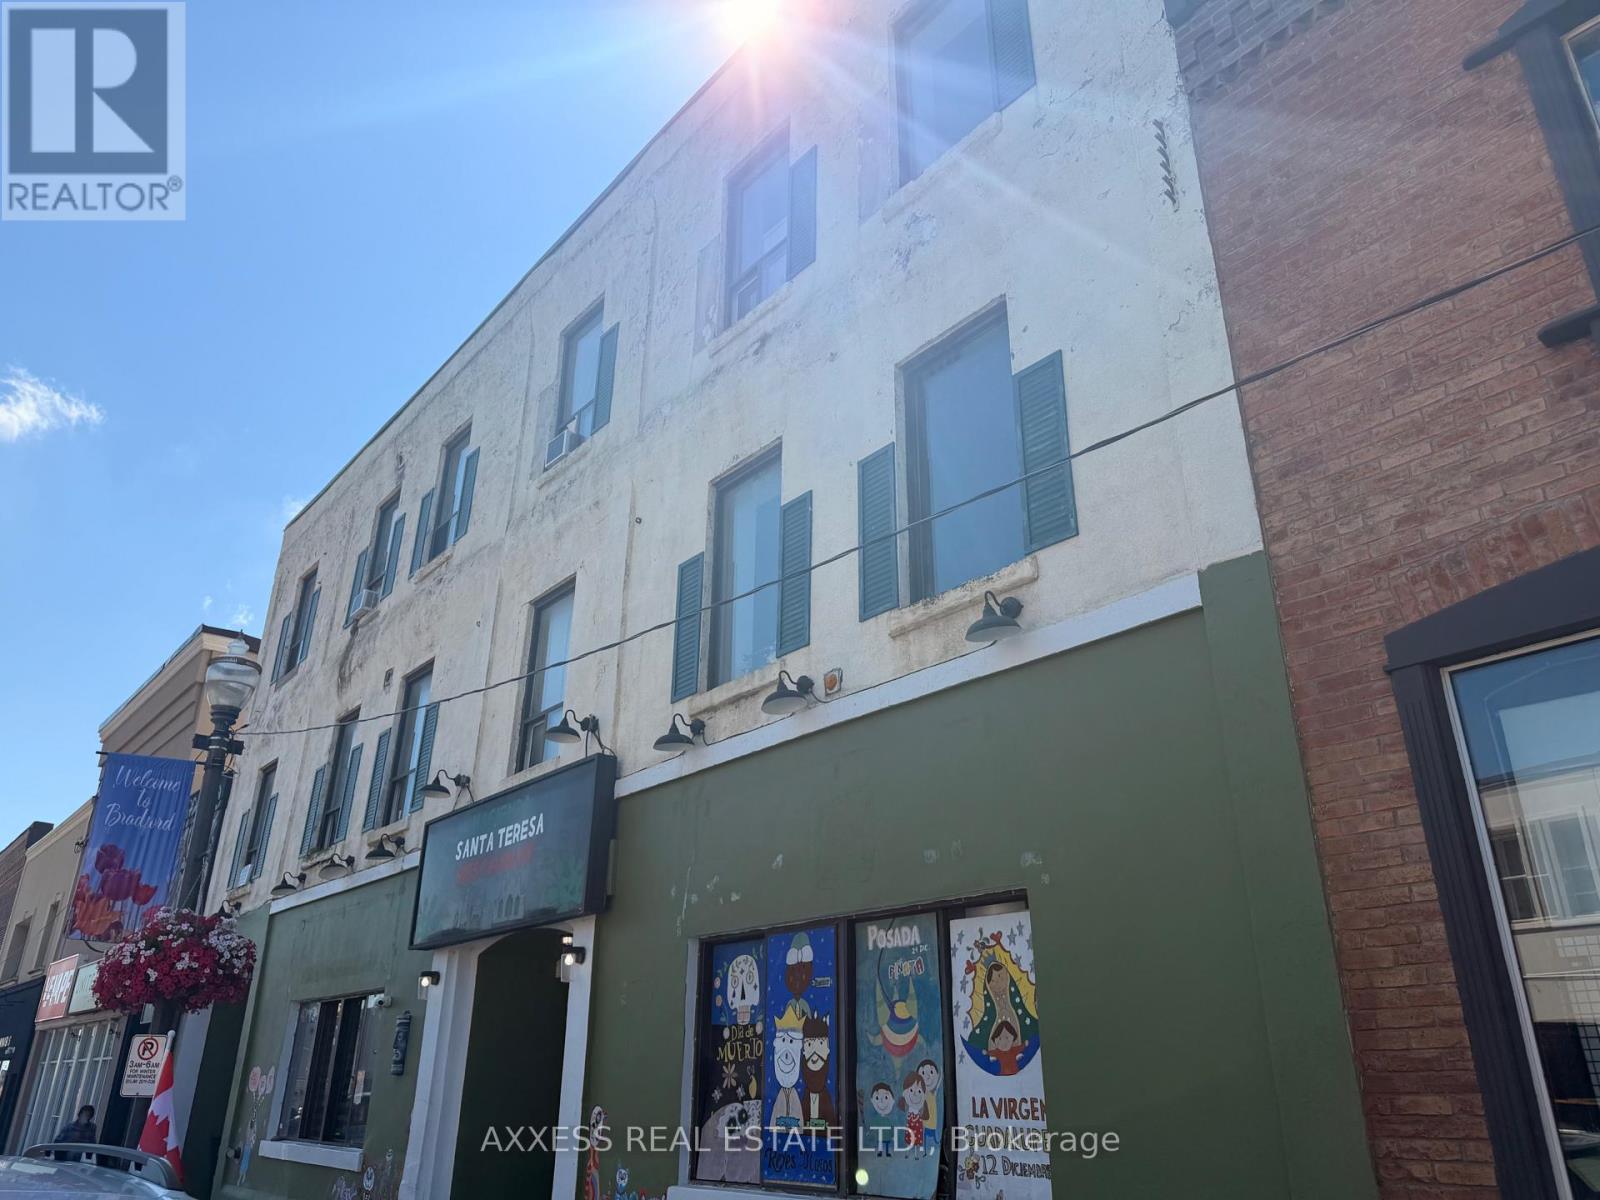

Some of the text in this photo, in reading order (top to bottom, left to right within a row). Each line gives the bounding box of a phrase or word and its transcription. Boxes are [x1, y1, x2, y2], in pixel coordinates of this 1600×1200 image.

[113, 765, 181, 792] Welcome
[136, 788, 151, 808] to
[455, 813, 544, 861] SANTA TERESA
[867, 924, 921, 951] POSADA
[971, 1096, 989, 1119] LA
[981, 1154, 998, 1175] 12
